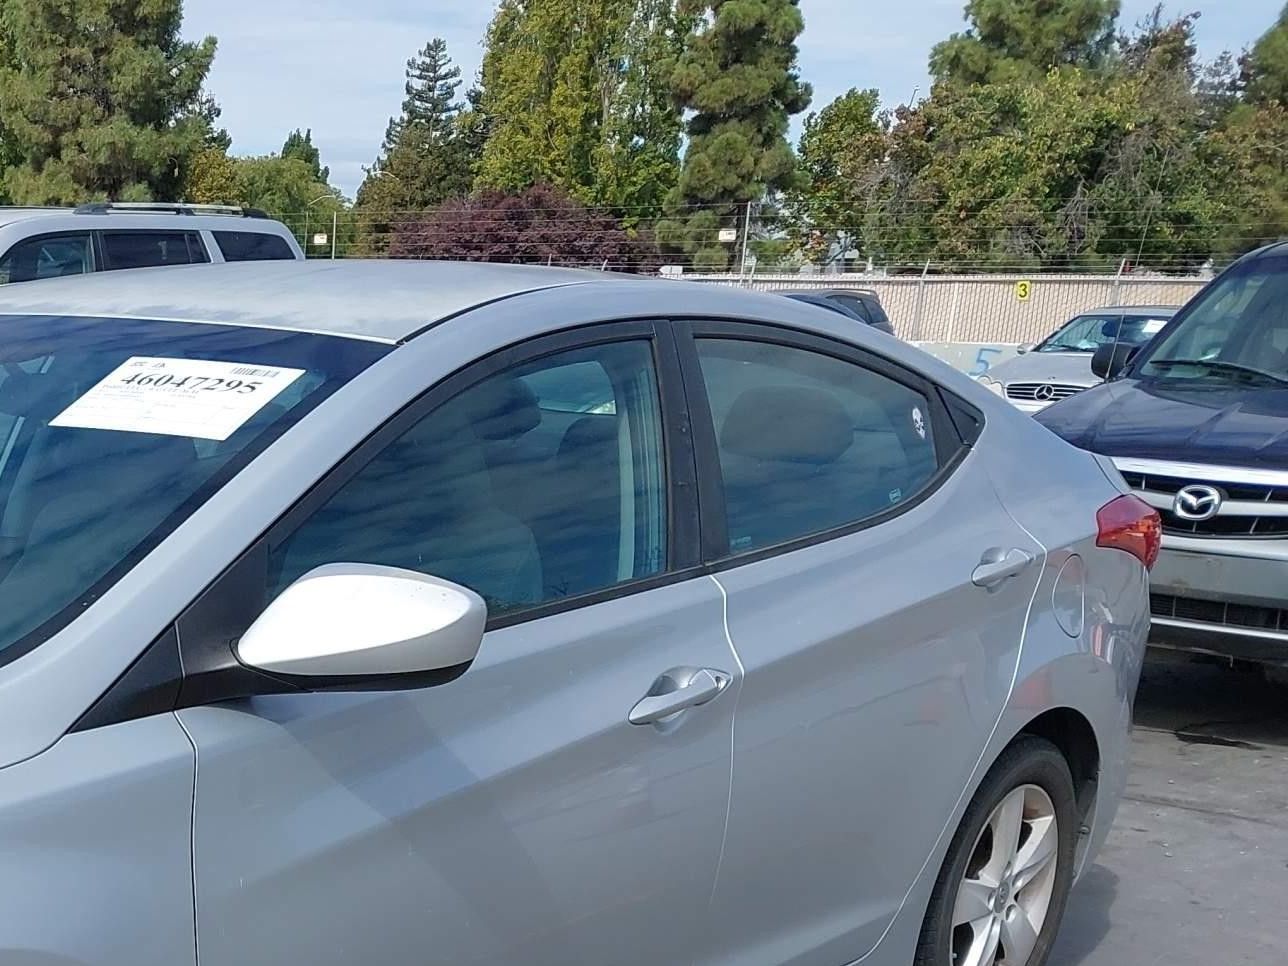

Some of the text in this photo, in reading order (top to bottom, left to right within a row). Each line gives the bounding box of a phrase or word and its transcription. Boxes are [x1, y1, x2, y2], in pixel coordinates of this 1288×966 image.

[1018, 283, 1028, 298] 3
[968, 347, 1002, 377] 5
[120, 372, 264, 394] 46047295
